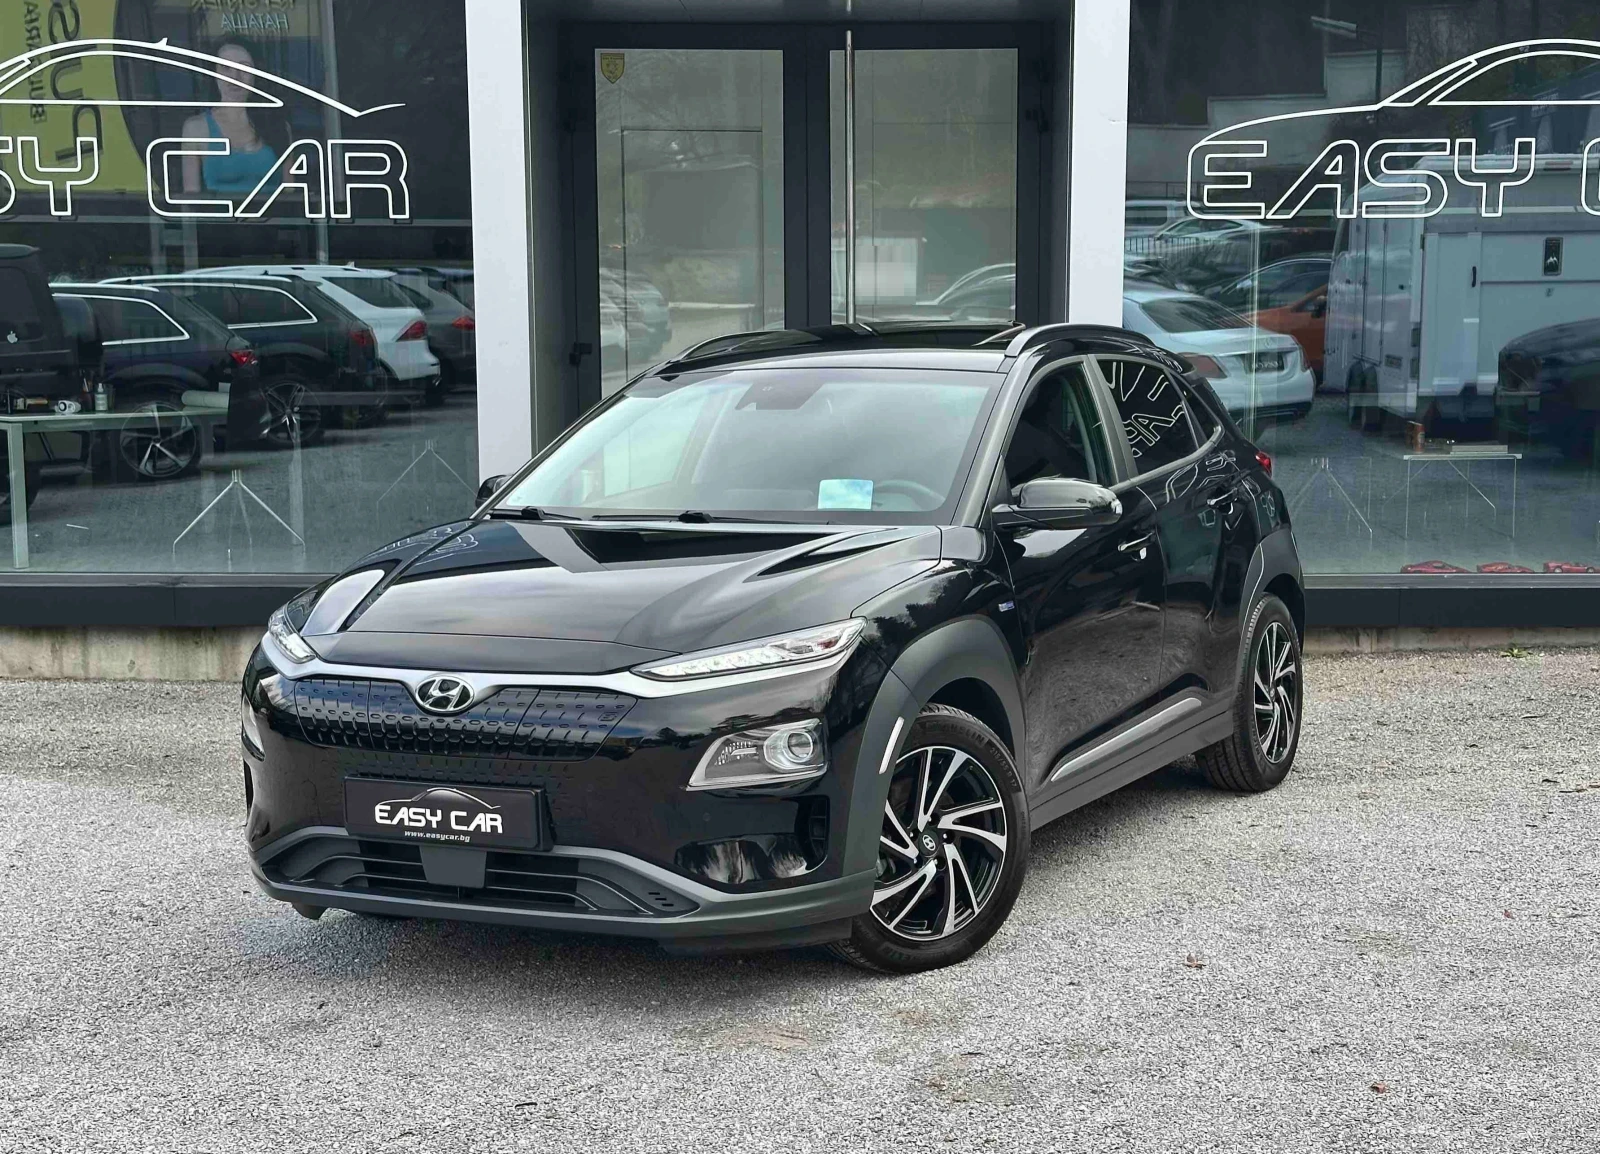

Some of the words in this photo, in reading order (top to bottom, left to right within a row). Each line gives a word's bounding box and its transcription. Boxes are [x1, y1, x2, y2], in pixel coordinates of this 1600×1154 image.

[146, 138, 410, 219] CAR
[1186, 138, 1536, 219] EASY
[374, 805, 443, 828] EASY
[450, 811, 503, 834] CAR
[404, 830, 471, 842] www.easycar.bg
